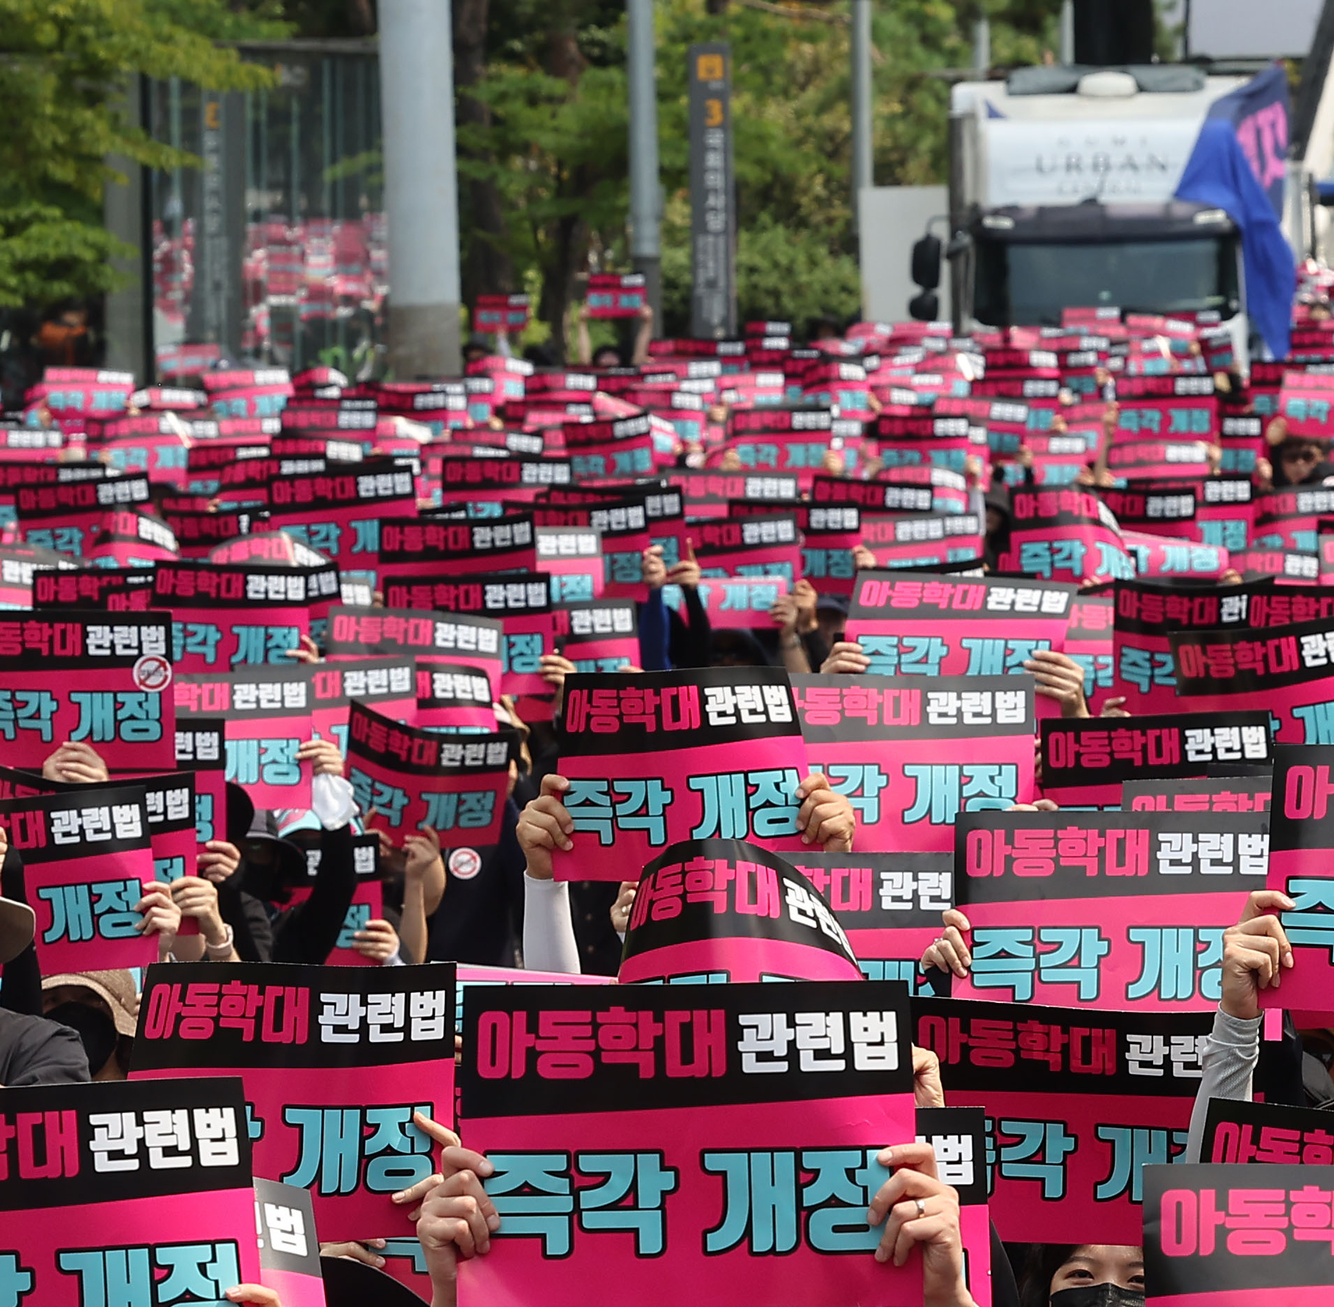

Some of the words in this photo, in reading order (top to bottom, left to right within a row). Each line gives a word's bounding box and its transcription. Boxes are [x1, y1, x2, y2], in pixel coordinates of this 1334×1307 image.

[1035, 152, 1169, 174] URBAN
[471, 521, 533, 549] 관련법
[1020, 538, 1087, 580] 즉각
[154, 569, 245, 599] 아동학대
[246, 572, 308, 601] 관련법
[484, 580, 549, 611] 관련법
[858, 579, 987, 612] 아동학대
[986, 586, 1071, 614] 관련법
[85, 623, 167, 656] 관련법
[230, 623, 302, 665] 개정
[433, 621, 499, 654] 관련법
[1178, 636, 1300, 680] 아동학대
[231, 681, 307, 710] 관련법
[342, 666, 412, 696] 관련법
[432, 672, 492, 702] 관련법
[68, 690, 164, 744] 개정
[566, 684, 701, 735] 아동학대
[703, 683, 793, 726] 관련법
[926, 690, 1027, 726] 관련법
[351, 711, 438, 767] 아동학대
[439, 741, 509, 768] 관련법
[1048, 727, 1182, 770] 아동학대
[1183, 725, 1269, 762] 관련법
[50, 803, 142, 845] 관련법
[561, 777, 673, 846] 즉각
[686, 769, 802, 840] 개정
[965, 826, 1150, 879] 아동학대
[36, 878, 145, 945] 개정
[633, 856, 781, 931] 아동학대
[968, 925, 1111, 1004] 즉각
[145, 980, 310, 1044] 아동학대
[317, 990, 446, 1044] 관련법
[477, 1005, 727, 1081] 아동학대
[736, 1011, 901, 1074] 관련법
[917, 1014, 1117, 1077] 아동학대
[88, 1106, 239, 1173] 관련법
[281, 1104, 435, 1196] 개정
[485, 1150, 678, 1259] 즉각
[700, 1148, 893, 1257] 개정
